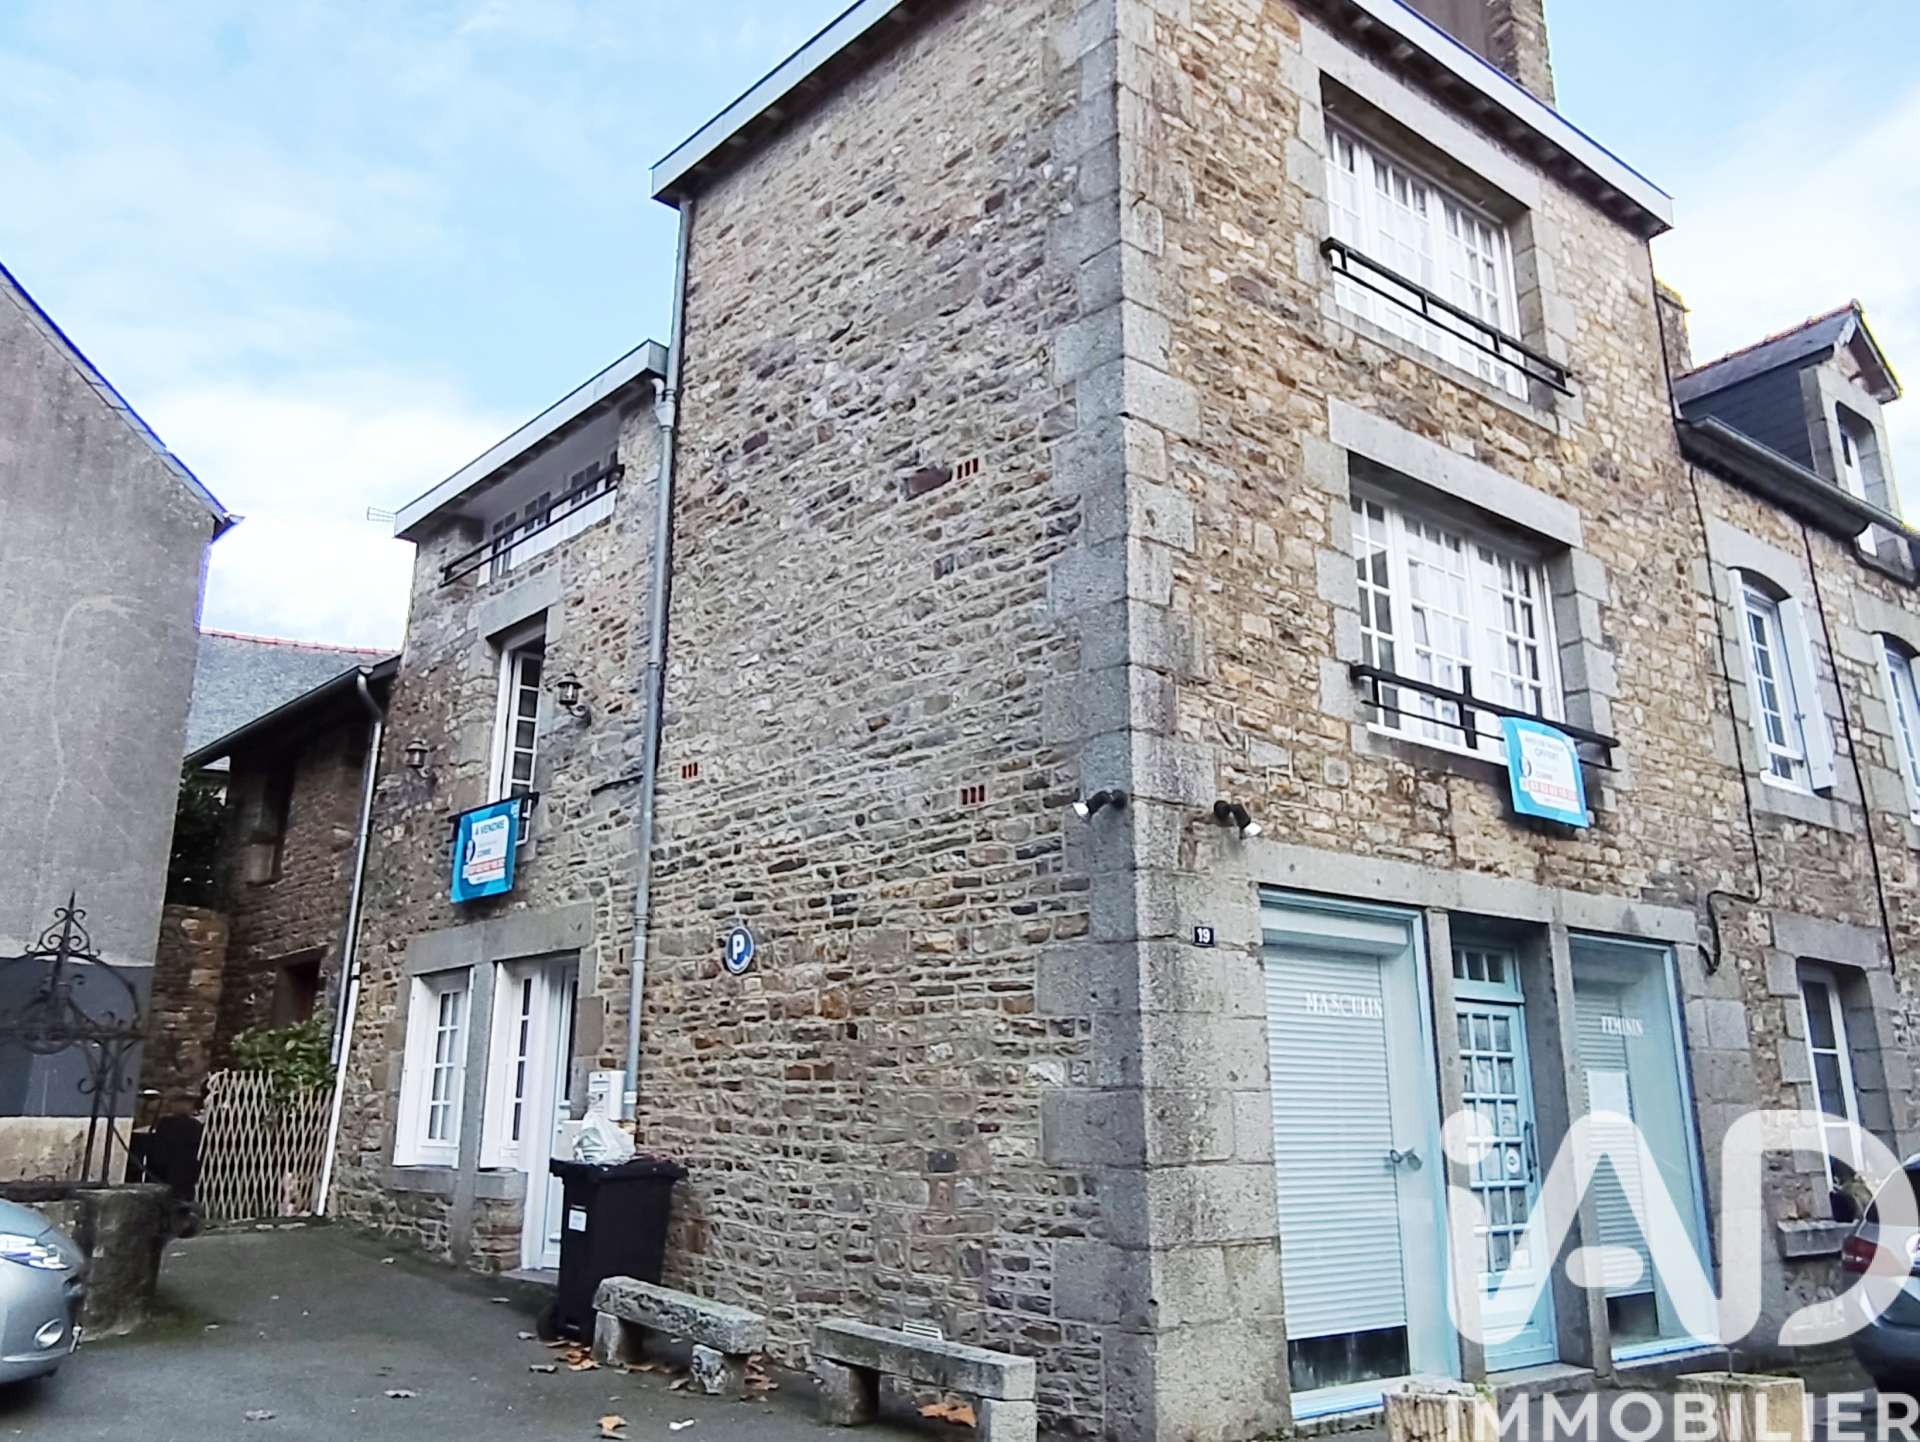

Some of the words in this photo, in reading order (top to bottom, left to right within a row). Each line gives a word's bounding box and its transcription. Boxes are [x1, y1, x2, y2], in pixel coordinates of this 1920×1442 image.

[732, 934, 745, 960] P
[1196, 927, 1211, 943] 19
[1305, 991, 1383, 1018] MASCULIN
